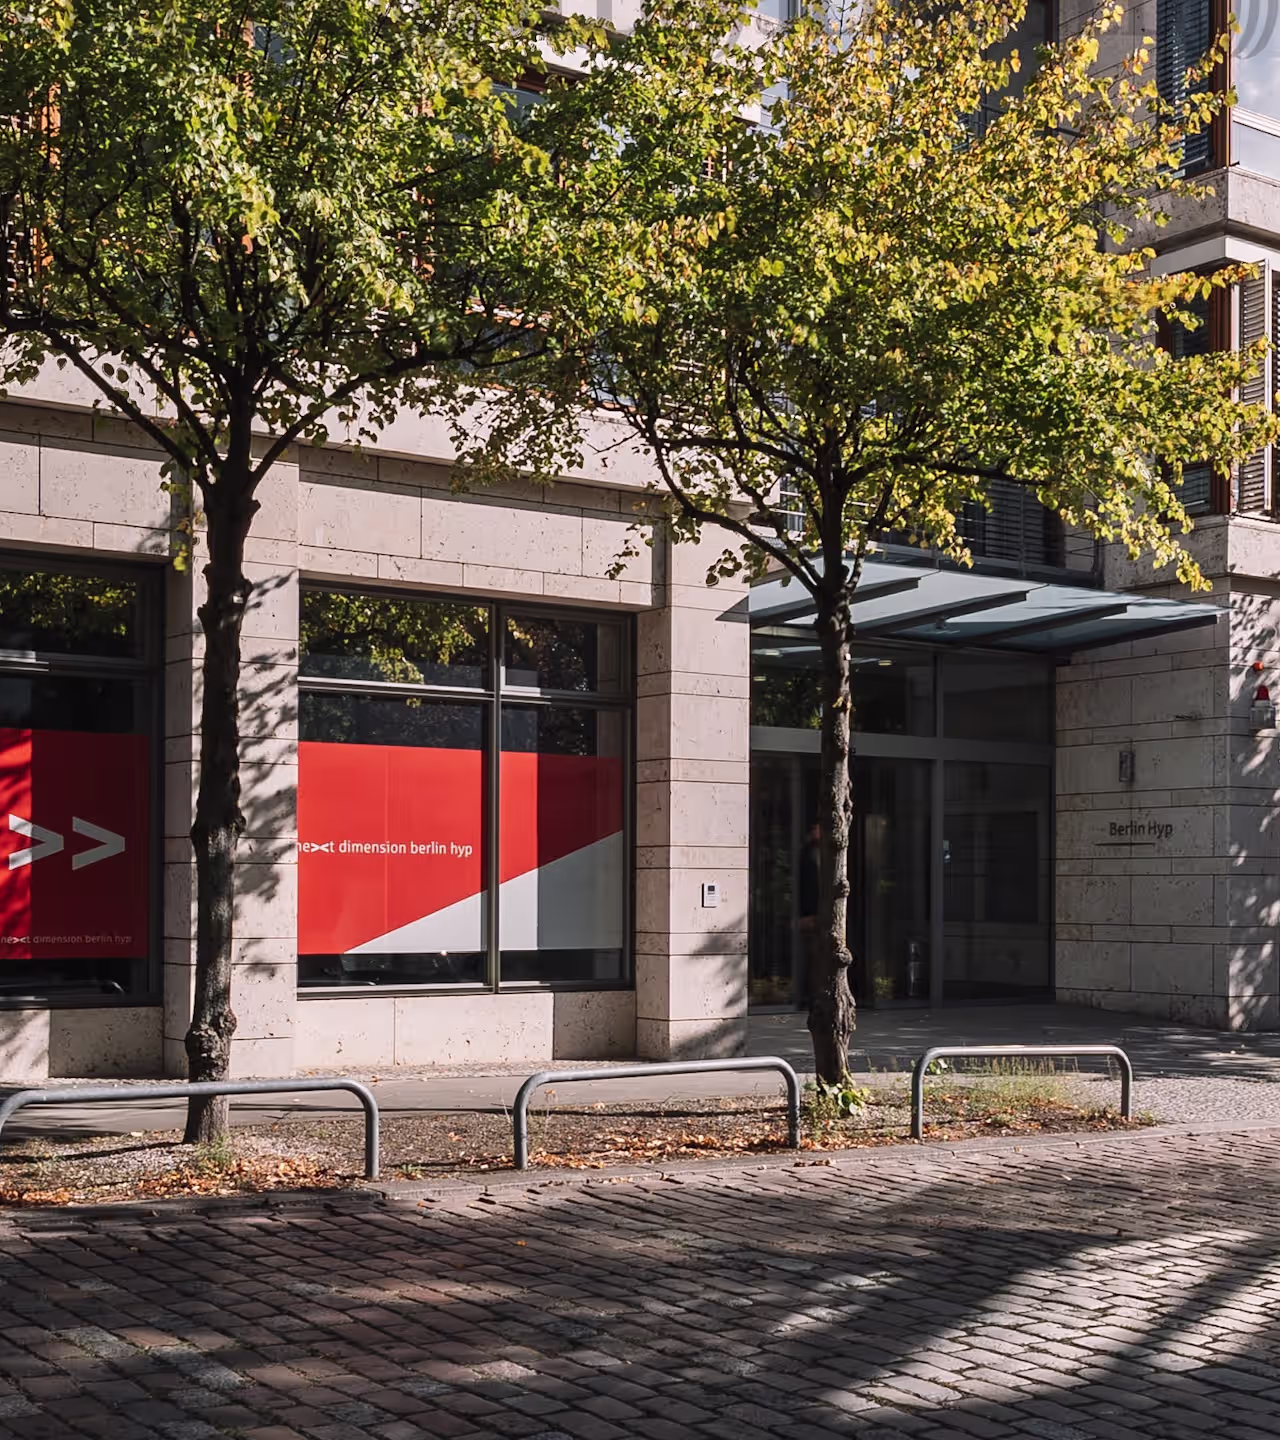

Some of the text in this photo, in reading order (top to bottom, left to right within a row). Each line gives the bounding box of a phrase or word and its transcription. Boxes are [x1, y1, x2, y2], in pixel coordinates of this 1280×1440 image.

[1109, 820, 1173, 839] Berlin Hyp
[339, 839, 407, 854] dimension
[410, 841, 447, 855] berlin
[450, 842, 473, 858] hyp
[33, 934, 83, 945] dimension
